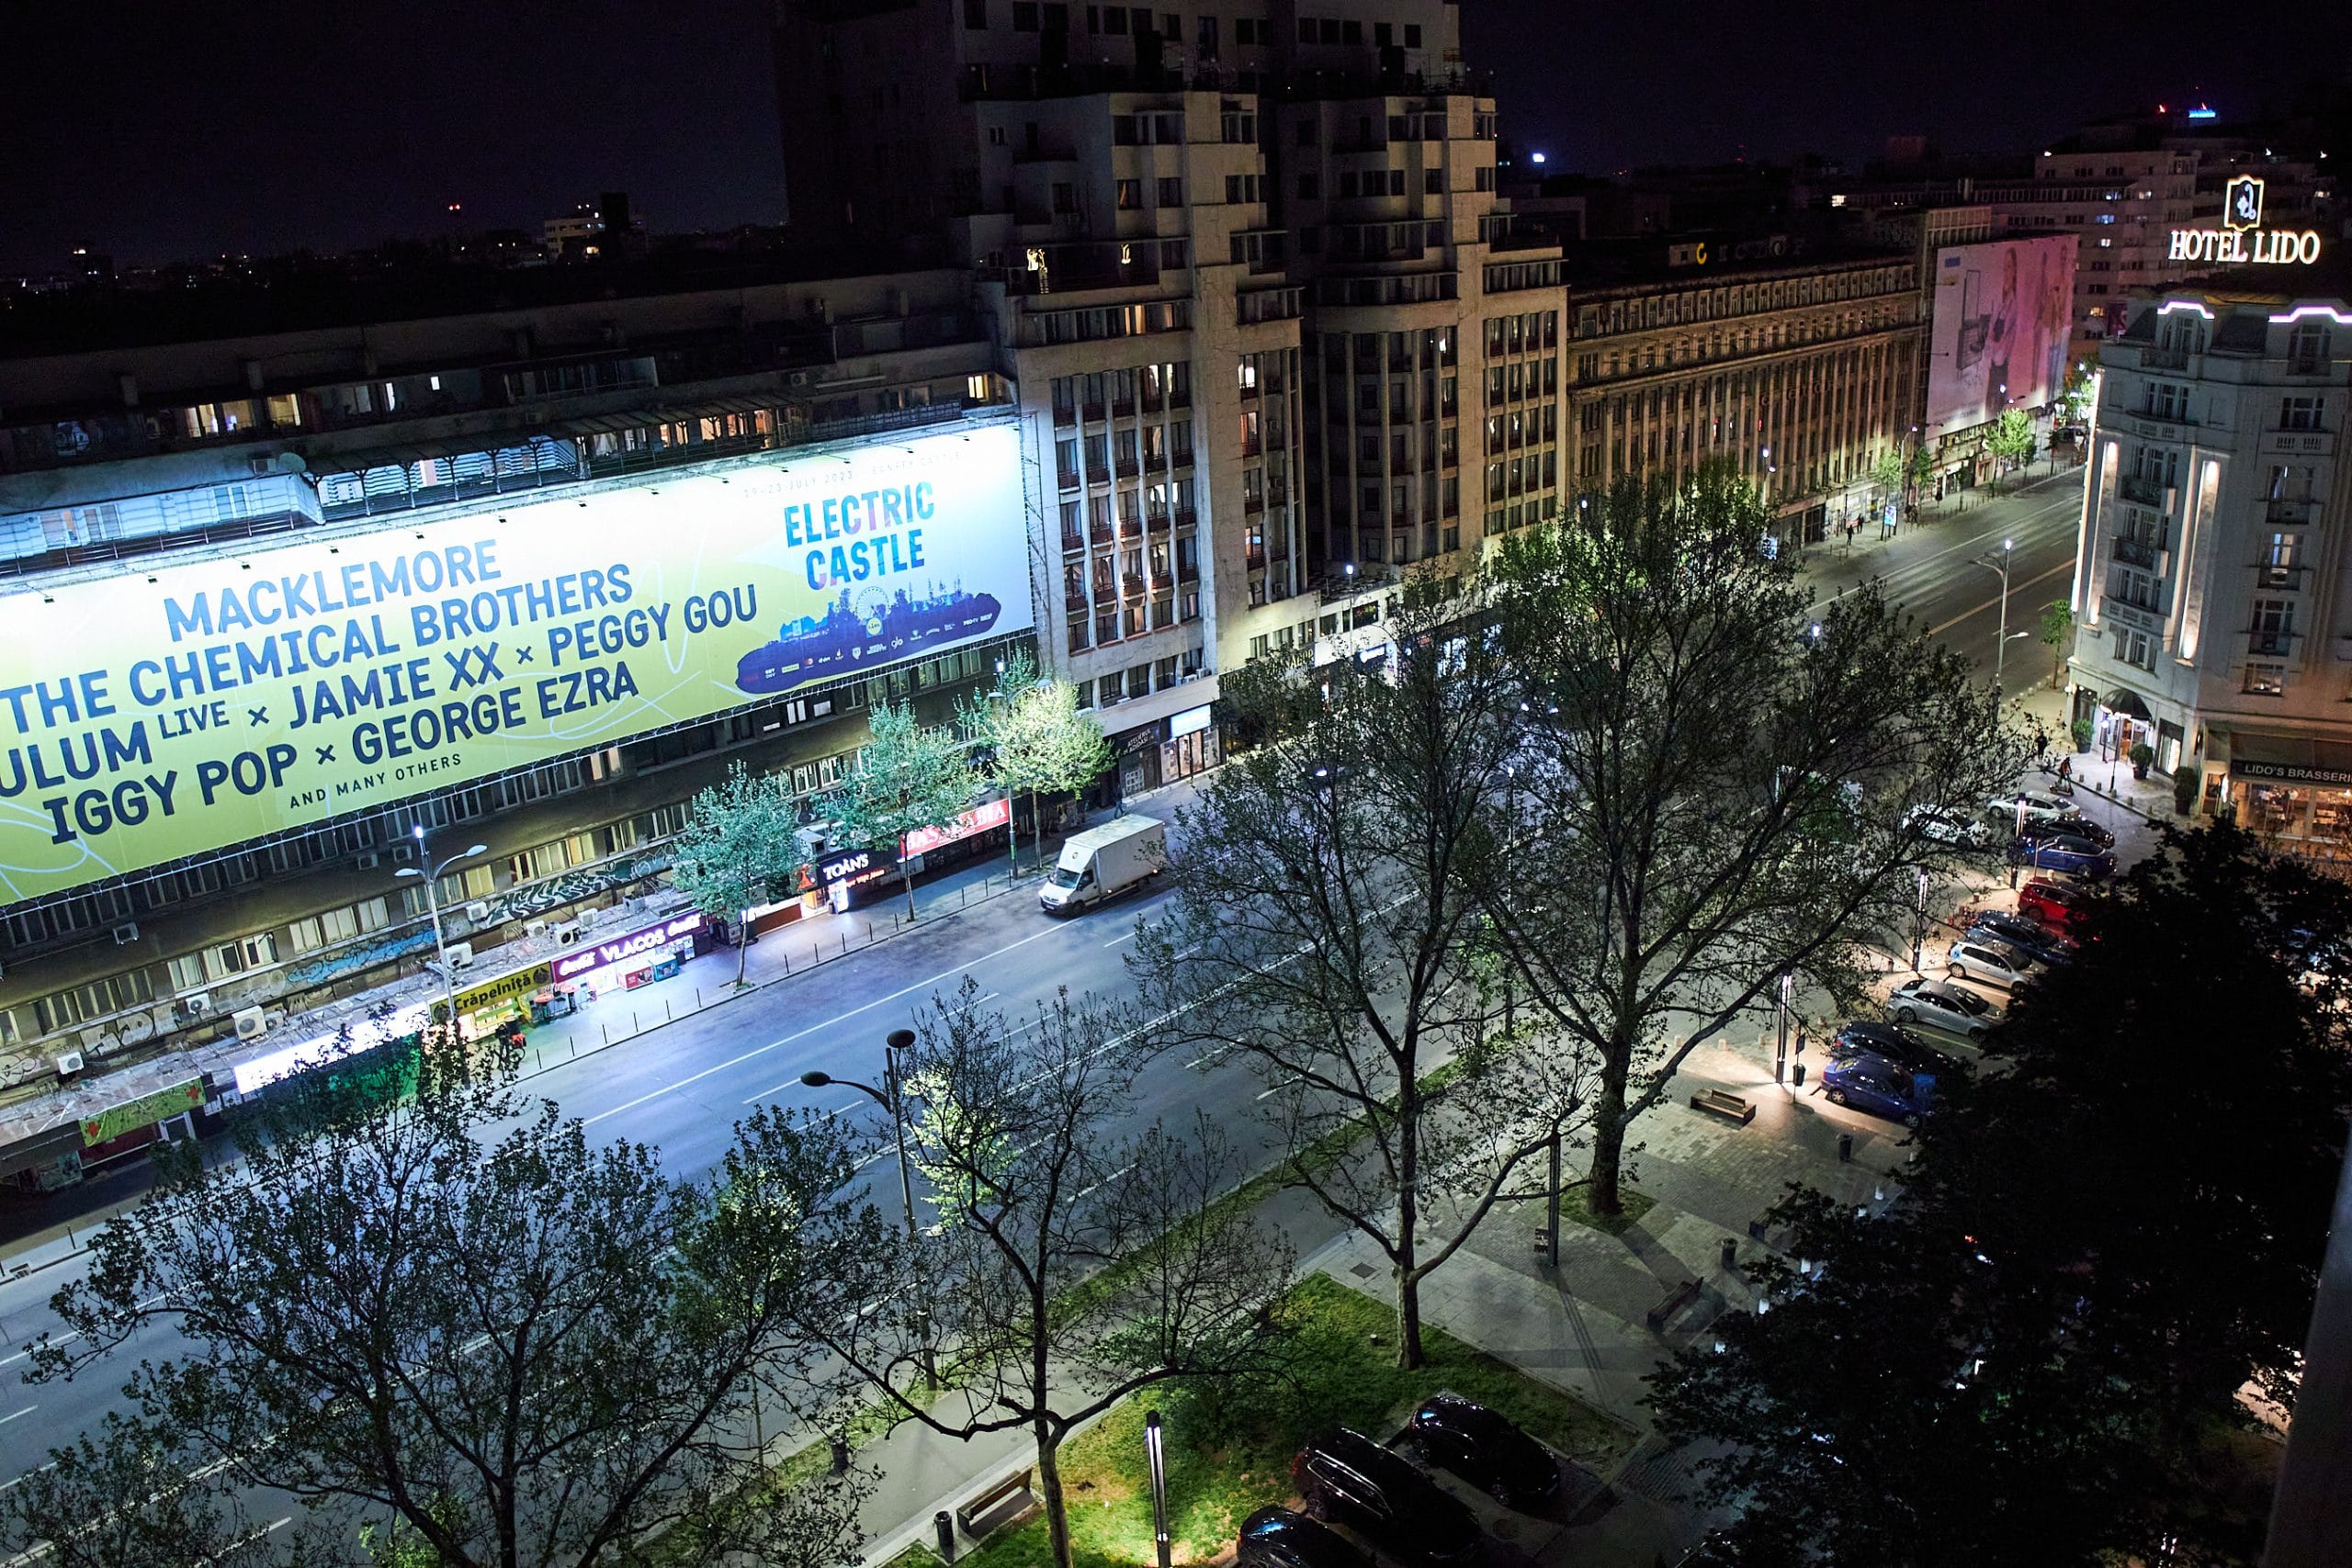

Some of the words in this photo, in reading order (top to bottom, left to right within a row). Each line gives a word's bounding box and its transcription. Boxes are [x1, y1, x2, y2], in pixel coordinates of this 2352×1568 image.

[2167, 230, 2248, 264] HOTEL
[2252, 230, 2322, 265] LIDO
[784, 481, 934, 548] ELECTRIC
[164, 539, 503, 642] MACKLEMORE
[806, 529, 925, 591] CASTLE
[0, 670, 117, 734] THE
[130, 615, 401, 707] CHEMICAL
[412, 563, 633, 648] BROTHERS
[157, 699, 231, 740] LIVE
[289, 657, 436, 730] JAMIE
[444, 641, 504, 692] XX
[548, 602, 671, 669] PEGGY
[684, 583, 758, 634] GOU
[42, 770, 178, 845] IGGY
[196, 743, 298, 807] POP
[352, 686, 526, 766] GEORGE
[537, 660, 639, 721] EZRA
[289, 788, 327, 810] AND
[336, 773, 386, 796] MANY
[395, 753, 461, 781] OTHERS
[2245, 764, 2285, 777] LIDO'S
[2288, 768, 2352, 783] BRASSERI
